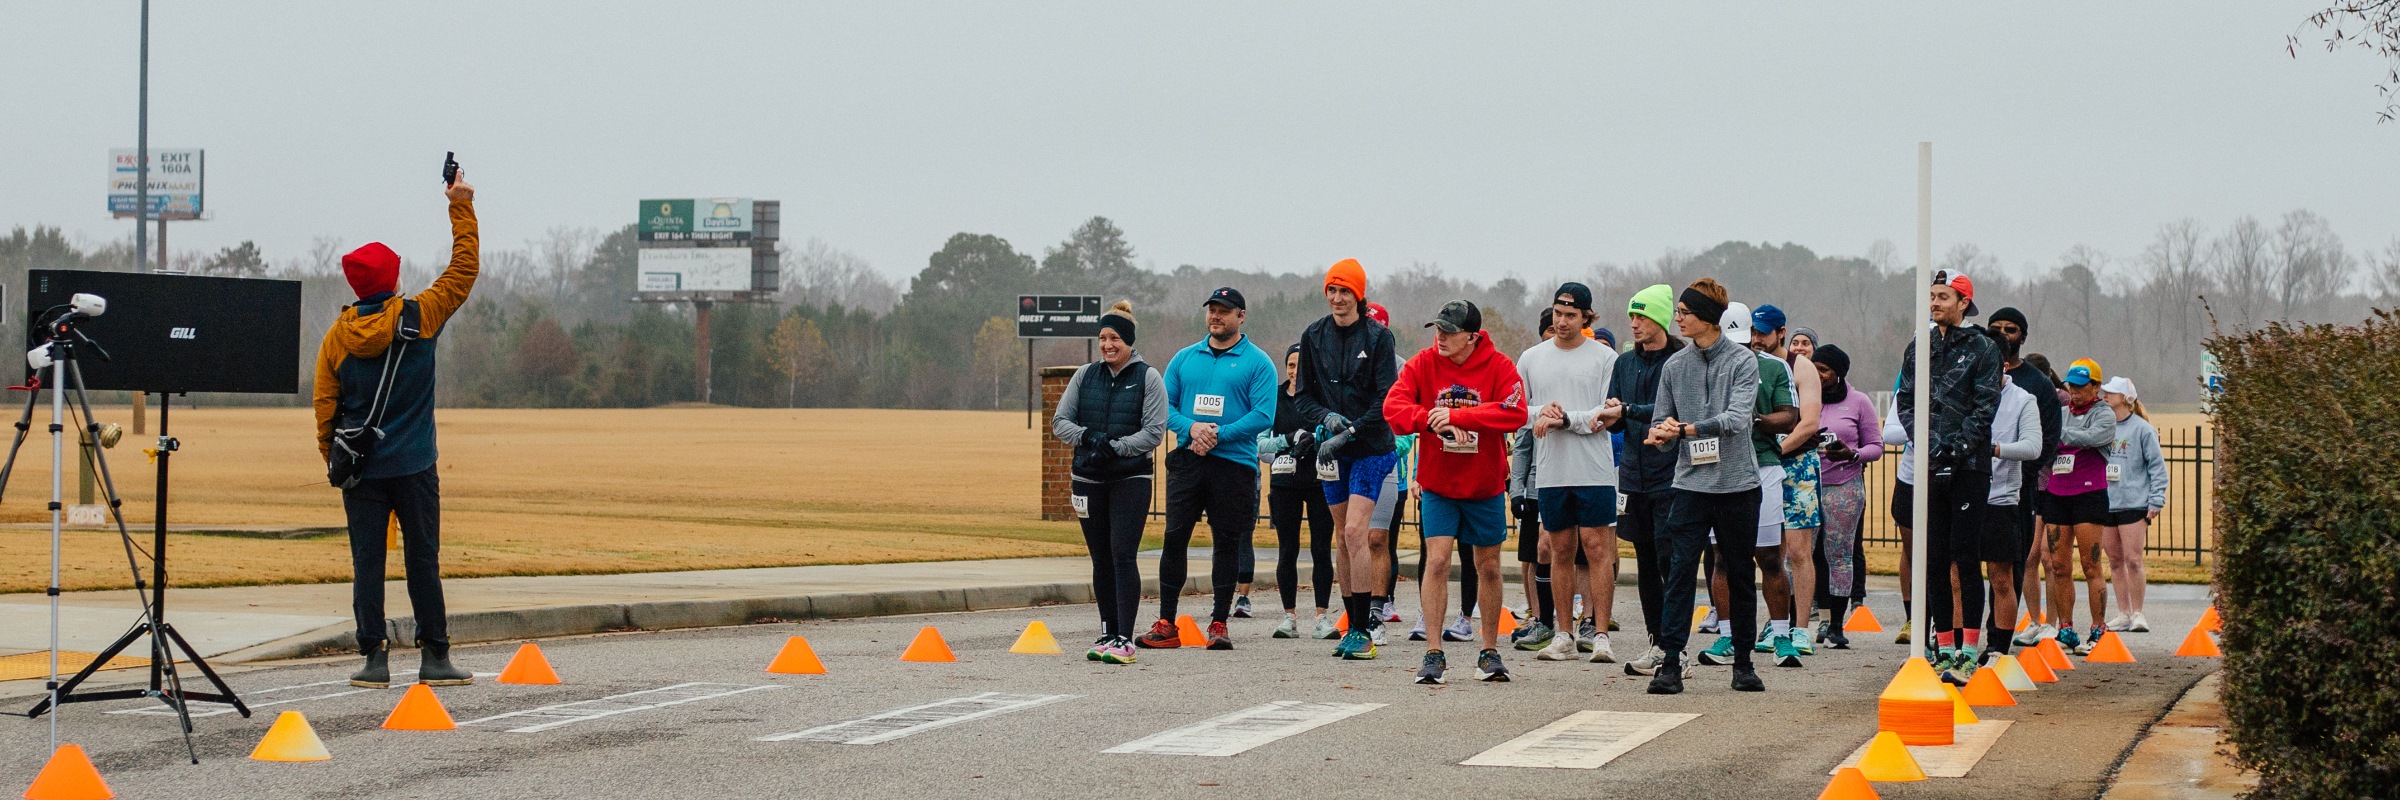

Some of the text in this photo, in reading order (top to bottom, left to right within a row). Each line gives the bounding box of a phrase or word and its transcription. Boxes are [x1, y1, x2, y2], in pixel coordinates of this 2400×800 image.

[161, 153, 191, 162] EXIT
[161, 164, 191, 173] 160A
[653, 216, 684, 226] QUINTA
[705, 218, 740, 227] Days Inn
[1019, 314, 1045, 323] GUEST
[1076, 315, 1099, 323] HOME
[169, 327, 196, 340] GILL
[1198, 396, 1221, 407] 1005
[1693, 440, 1716, 453] 1015
